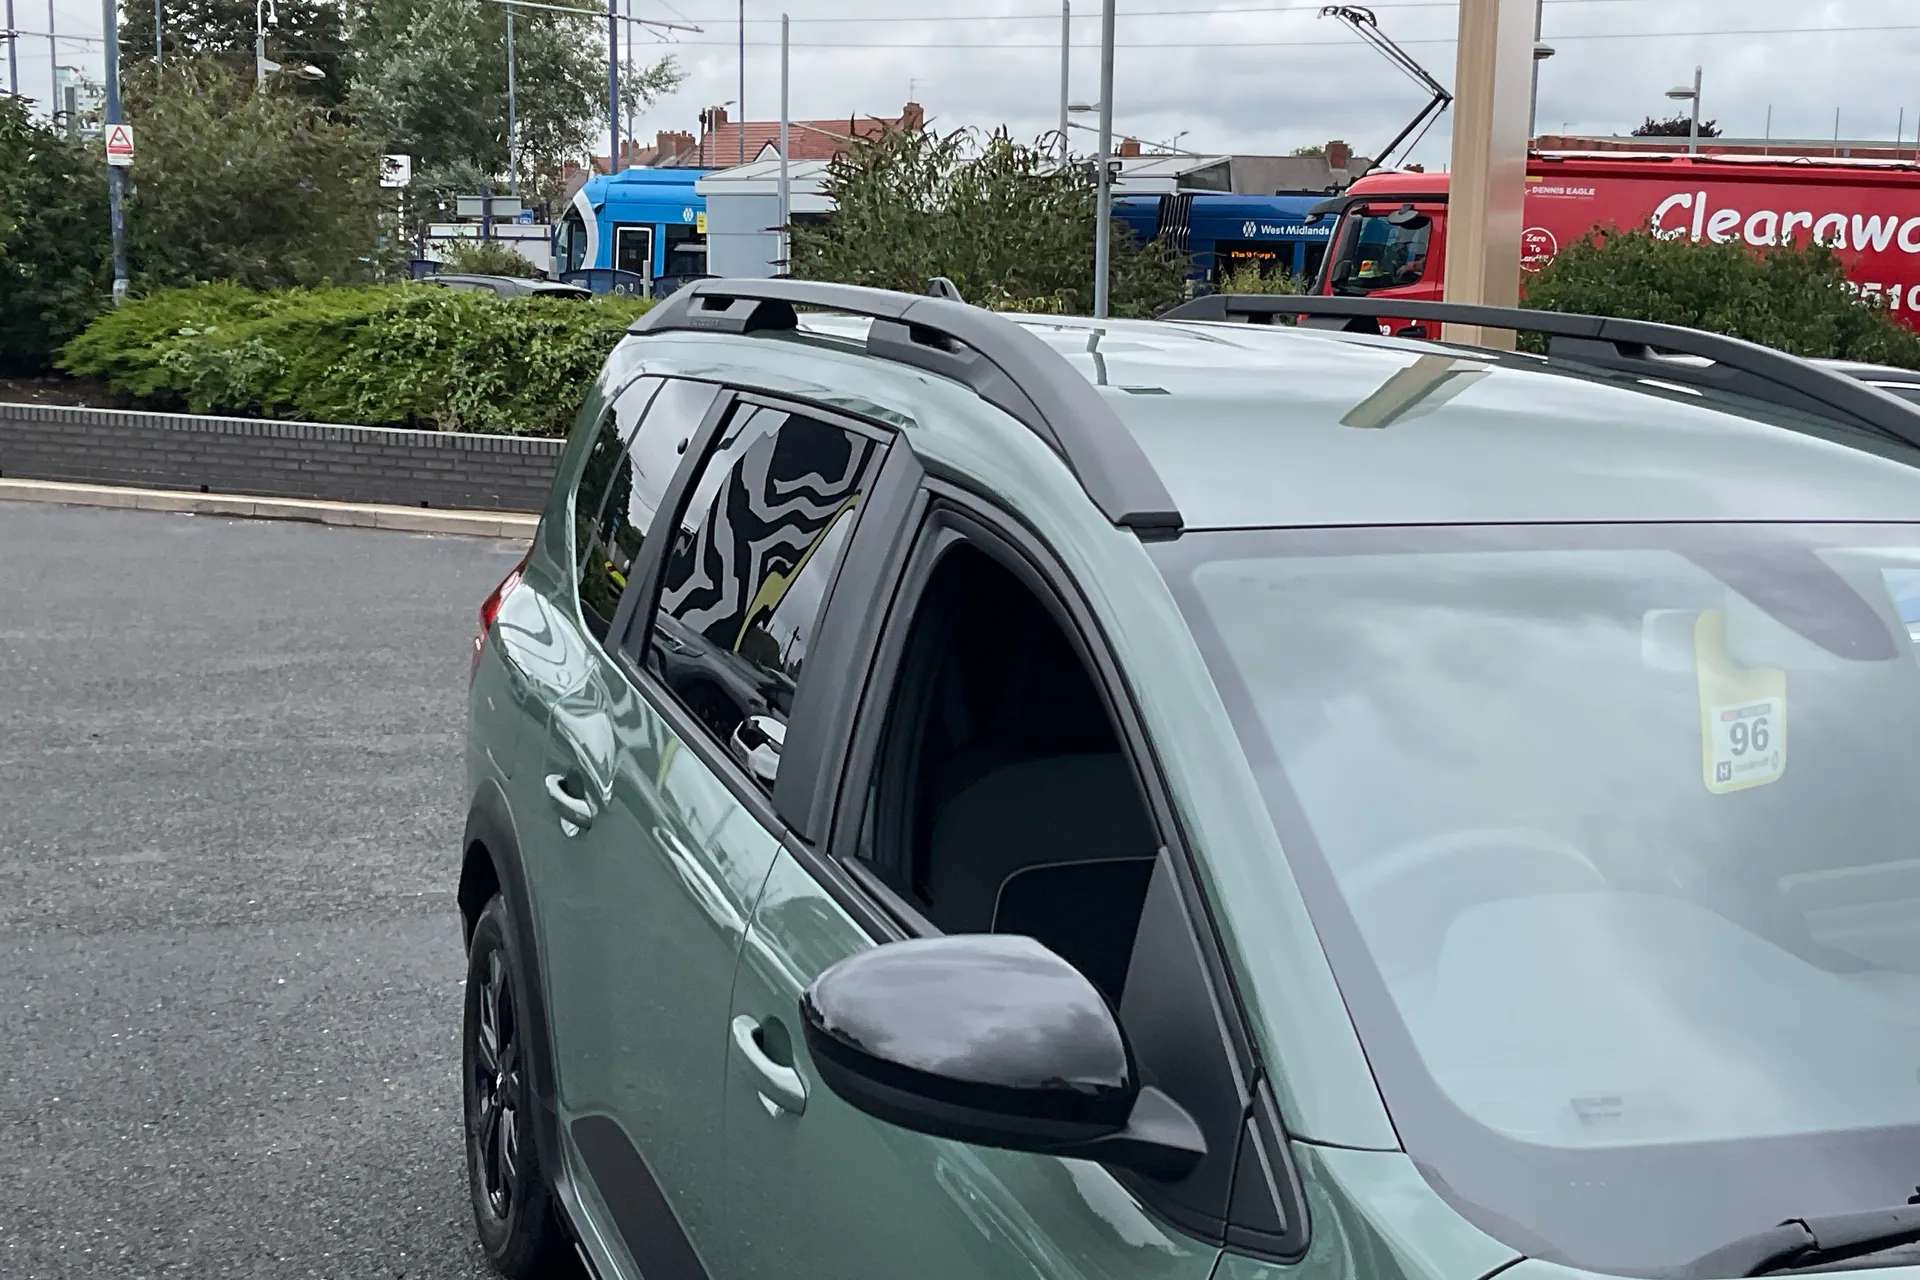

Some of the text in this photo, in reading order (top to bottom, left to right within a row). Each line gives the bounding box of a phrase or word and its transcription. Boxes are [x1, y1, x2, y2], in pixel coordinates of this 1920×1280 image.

[1532, 186, 1596, 196] DENNIS EAGLE
[1261, 225, 1330, 236] West Midlands
[1525, 233, 1547, 243] Zero
[1529, 244, 1541, 253] To
[1730, 717, 1769, 756] 96
